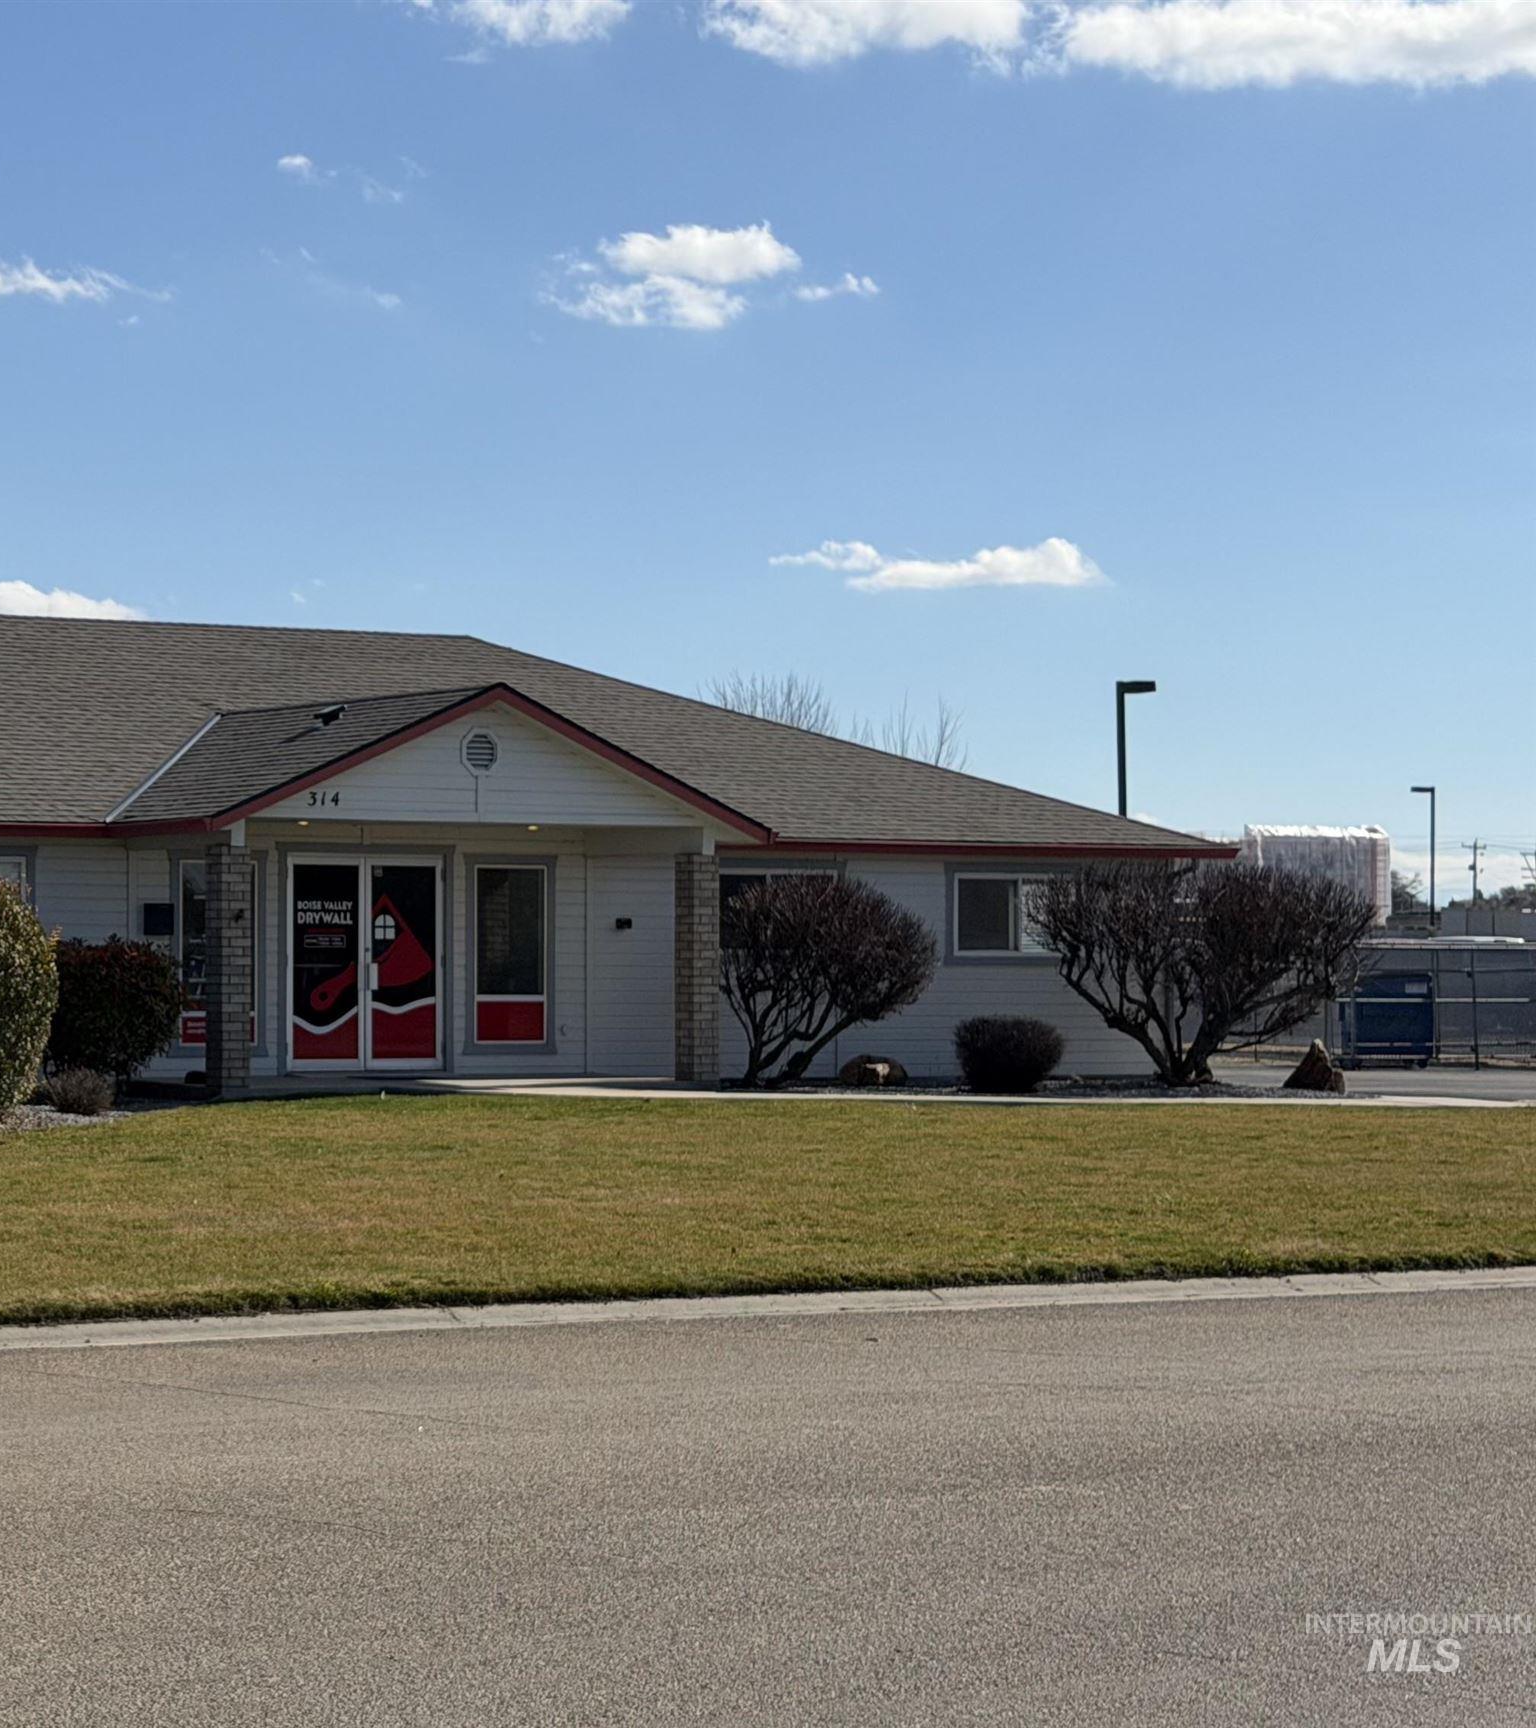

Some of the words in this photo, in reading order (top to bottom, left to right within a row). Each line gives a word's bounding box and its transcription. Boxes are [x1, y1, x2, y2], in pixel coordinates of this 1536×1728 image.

[307, 791, 340, 806] 314
[296, 900, 322, 910] BOISE
[323, 900, 353, 910] VALLEY
[296, 911, 353, 925] DRYWALL
